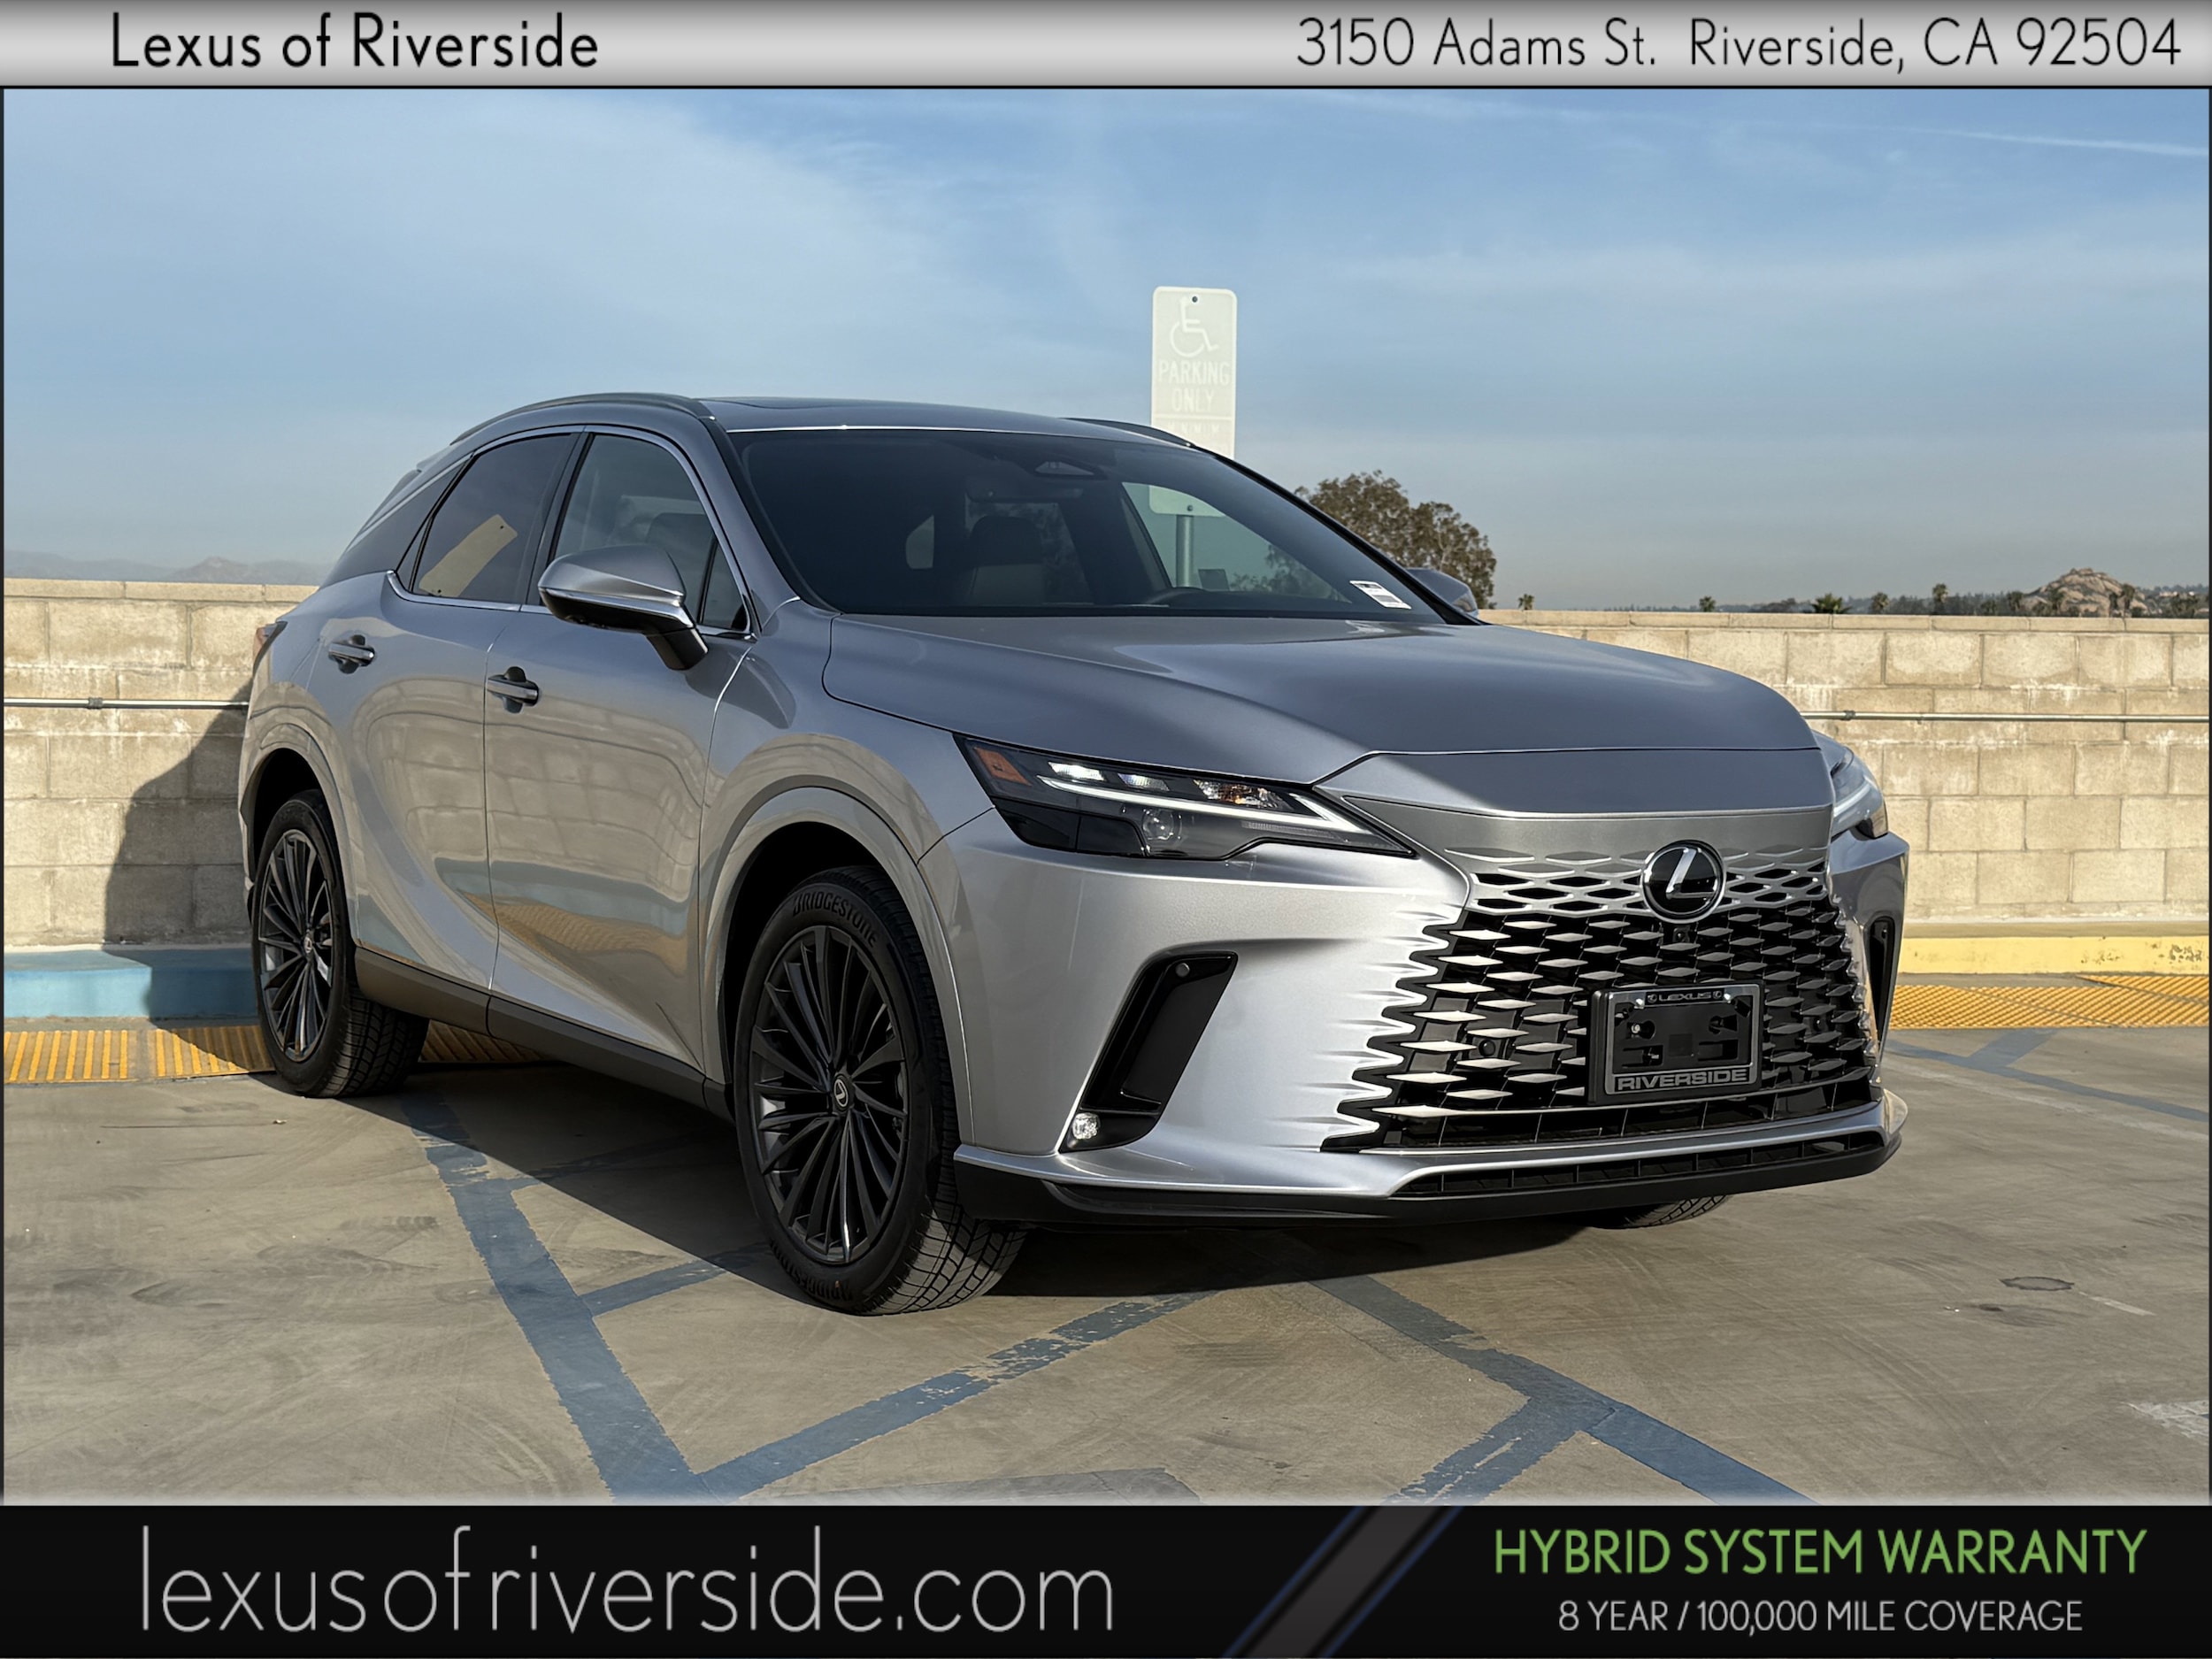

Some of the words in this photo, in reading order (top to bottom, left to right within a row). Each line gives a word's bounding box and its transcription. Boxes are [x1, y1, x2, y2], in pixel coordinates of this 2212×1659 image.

[1158, 360, 1231, 386] PARKING
[1171, 387, 1215, 413] ONLY
[793, 890, 879, 948] BRIDGESTONE
[1658, 991, 1712, 1002] LEXUS
[1617, 1069, 1748, 1090] RIVERSIDE
